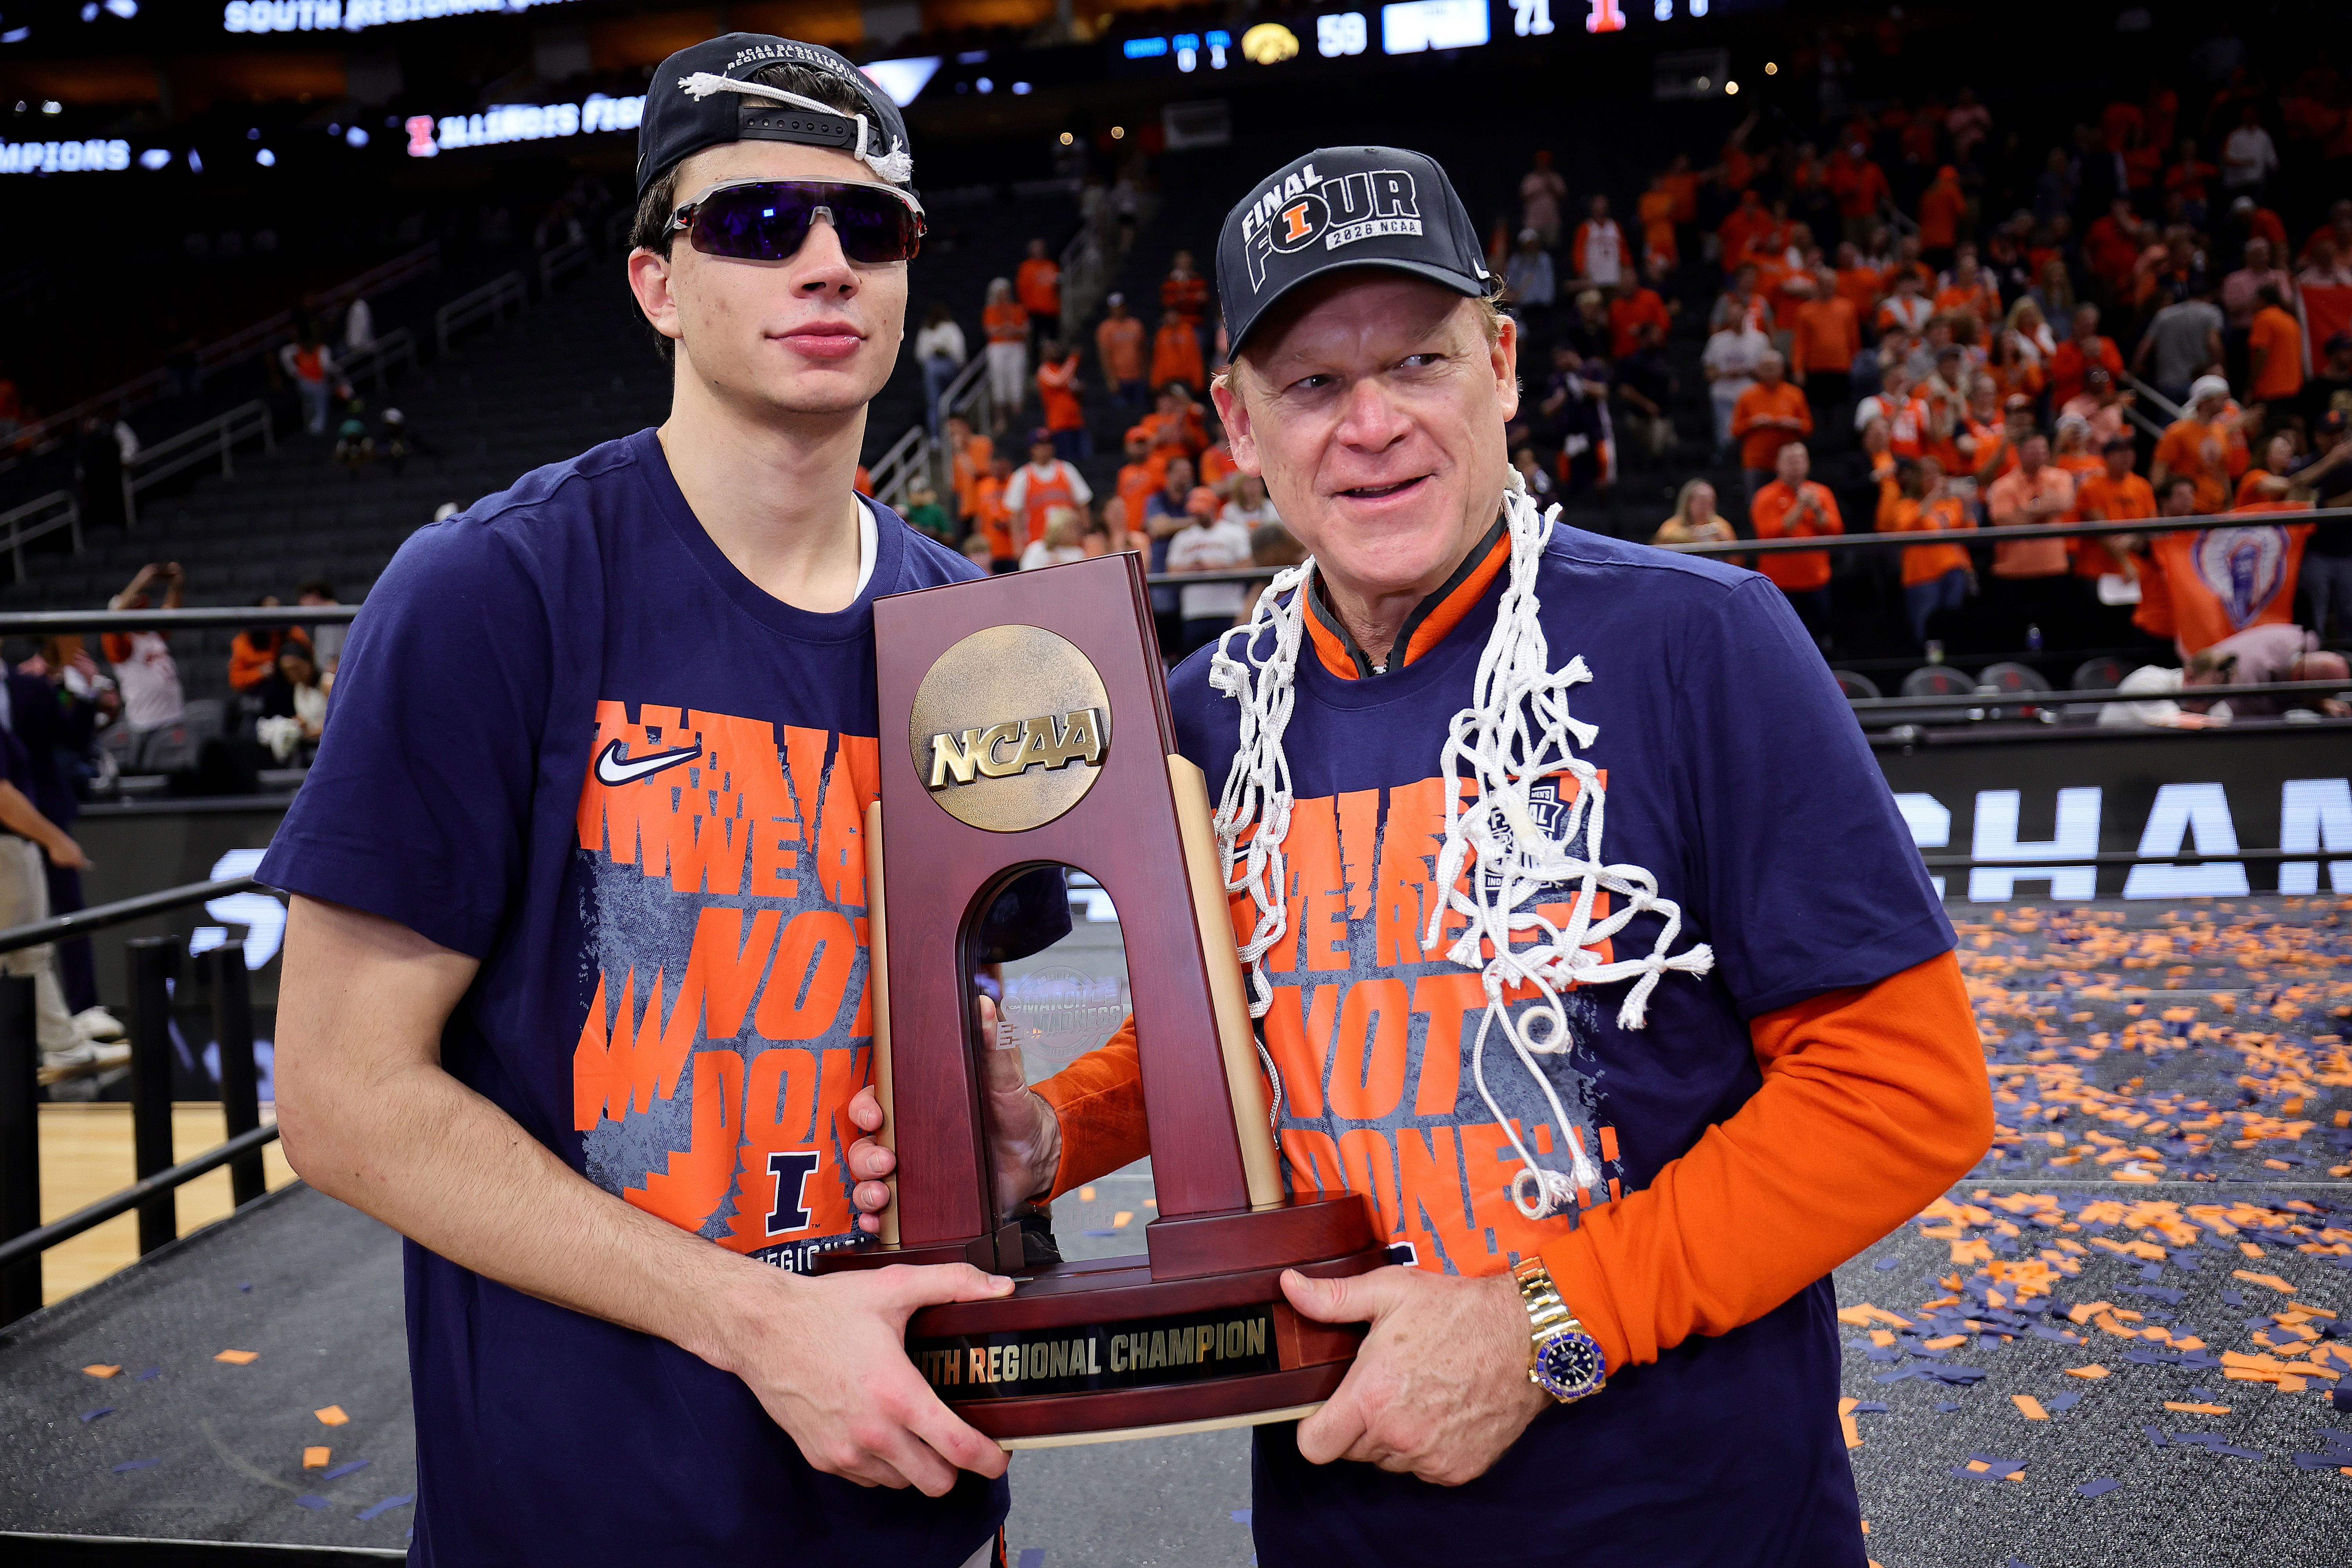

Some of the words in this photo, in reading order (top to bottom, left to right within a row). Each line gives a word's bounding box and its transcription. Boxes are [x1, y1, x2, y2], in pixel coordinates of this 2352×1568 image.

[224, 0, 342, 32] SOUTH
[1318, 12, 1367, 58] 59
[728, 50, 793, 71] REGIONAL
[737, 44, 773, 58] NCAA
[1242, 163, 1323, 243] FINAL
[1381, 221, 1417, 232] NCAA
[929, 708, 1108, 791] NCAA
[1491, 804, 1548, 829] FAL
[1023, 987, 1087, 1014] MARCH
[1032, 1005, 1121, 1033] MADNESS
[1263, 973, 1509, 1120] NOT
[914, 1349, 960, 1385] UTH
[969, 1337, 1101, 1384] REGIONAL
[1111, 1318, 1266, 1373] CHAMPION
